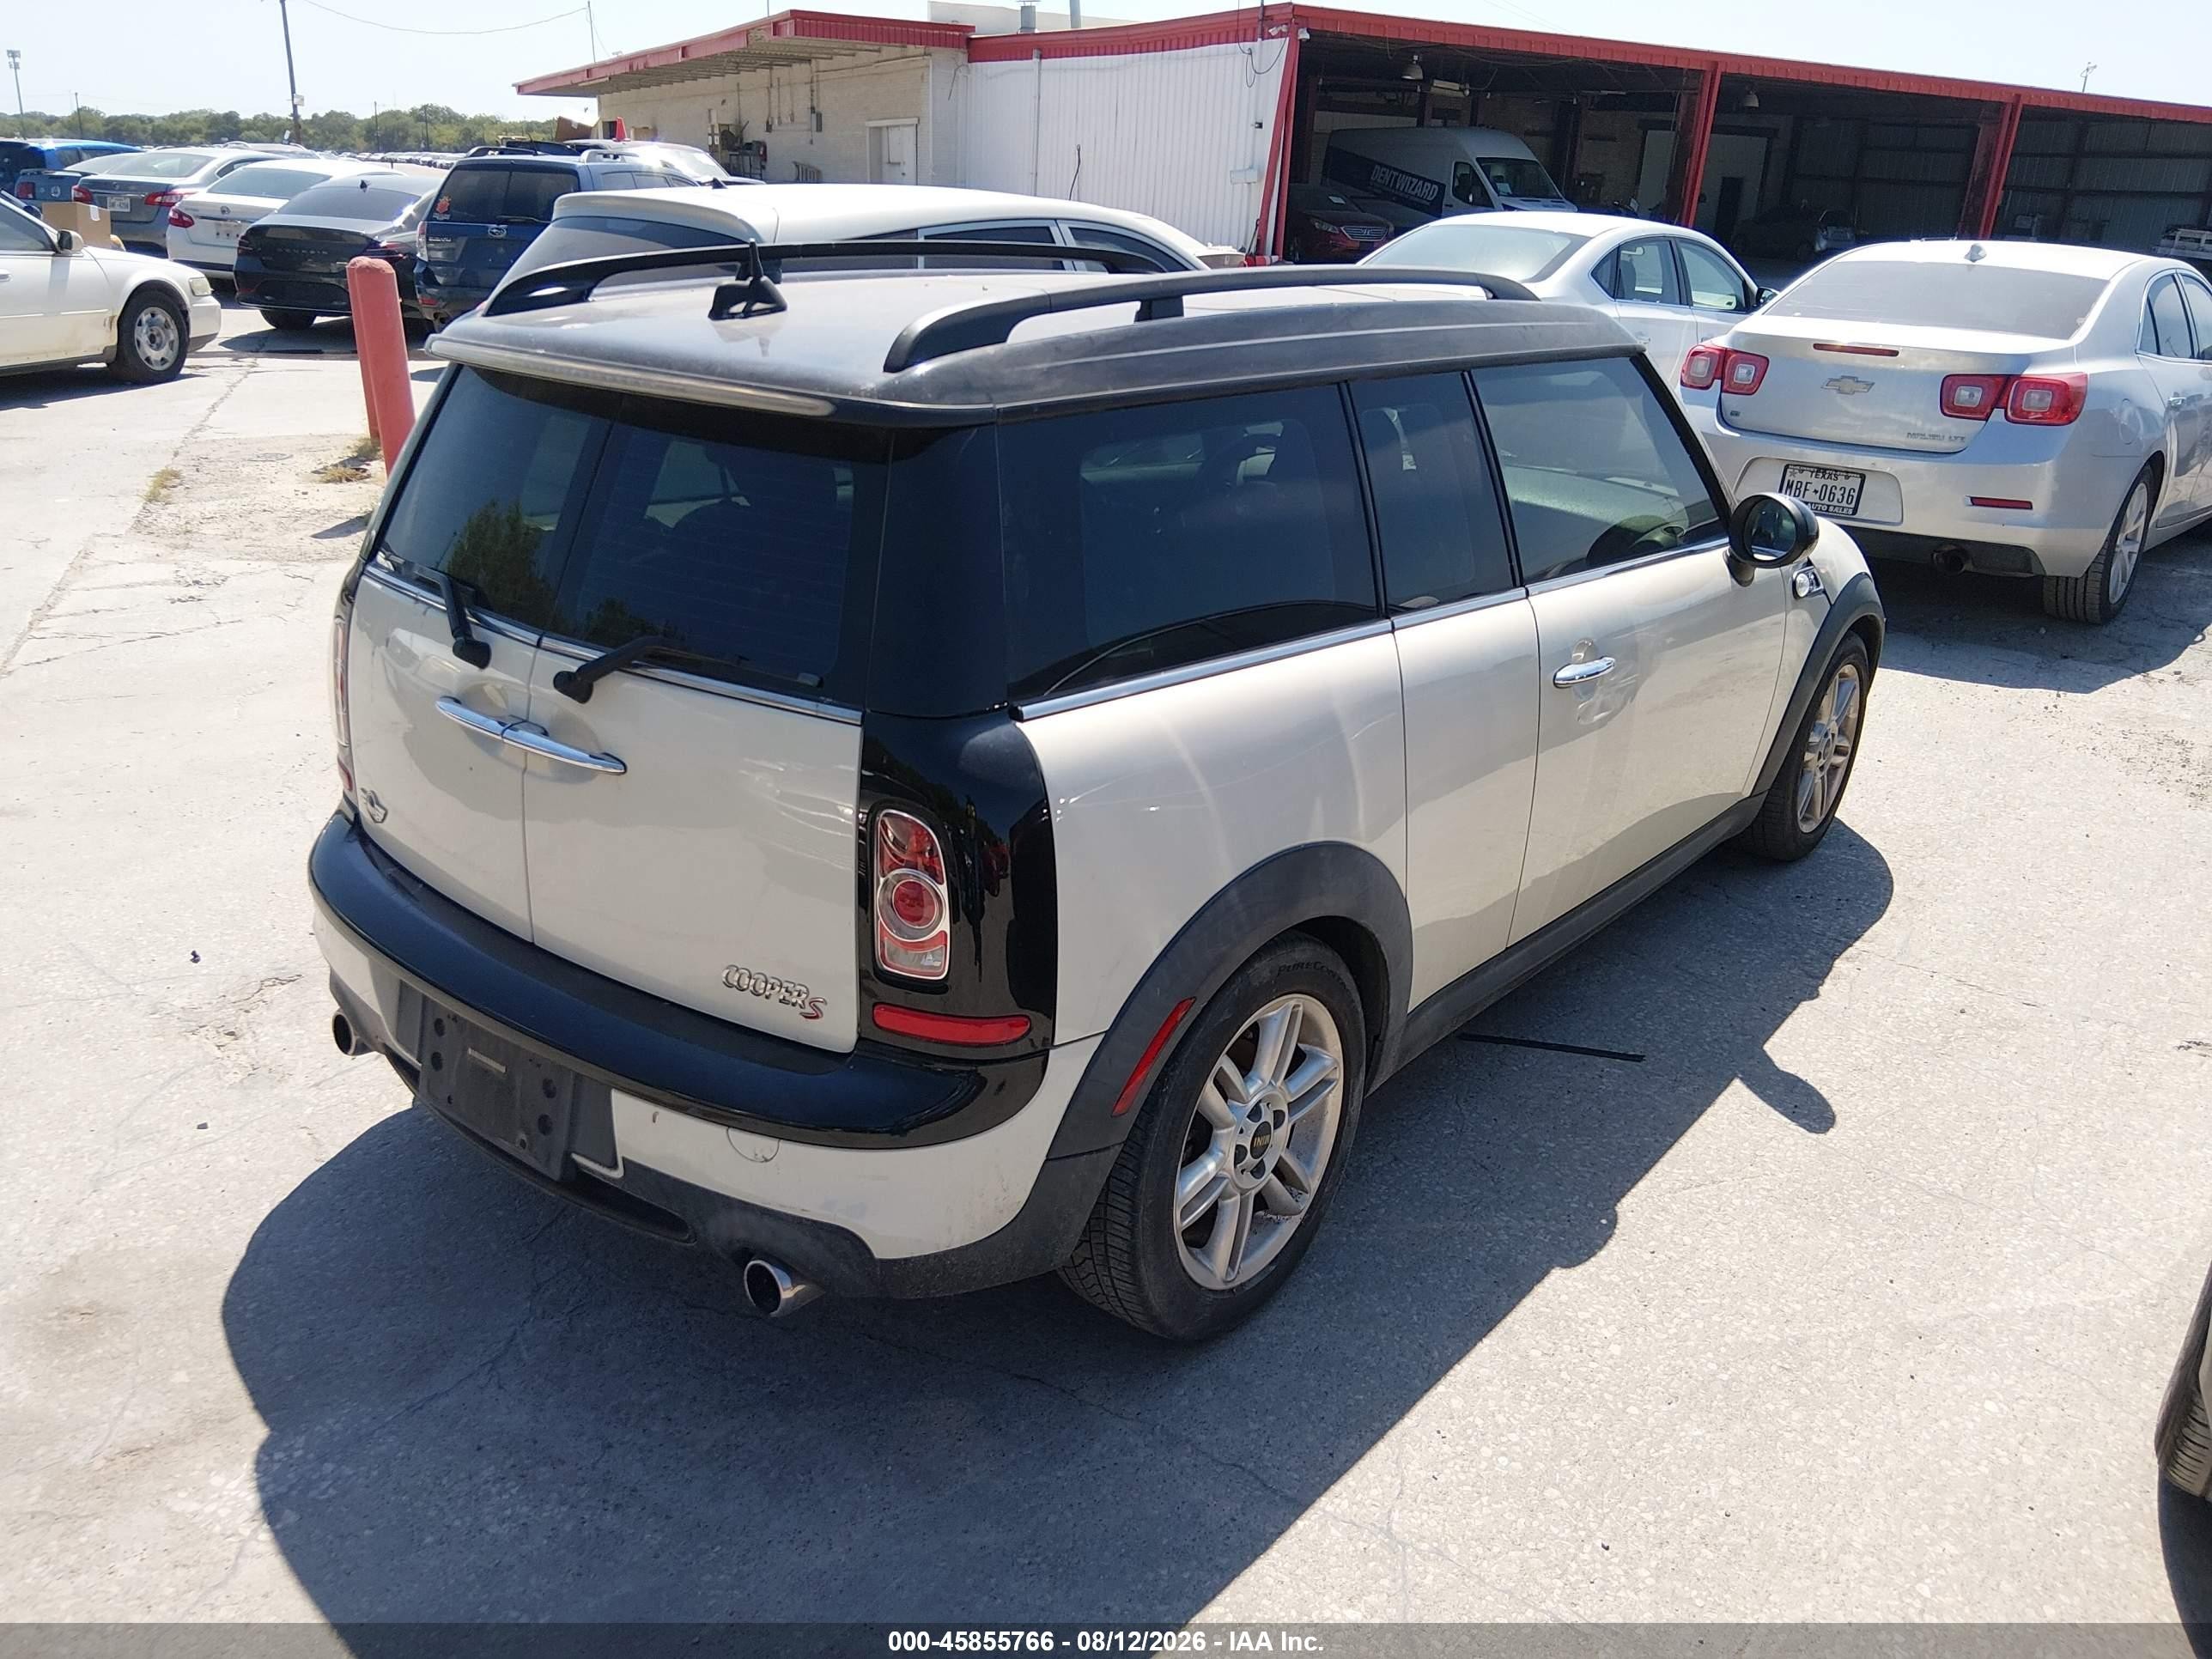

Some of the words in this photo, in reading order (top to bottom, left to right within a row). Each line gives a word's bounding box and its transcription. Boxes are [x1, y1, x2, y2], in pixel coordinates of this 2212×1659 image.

[1809, 469, 1838, 482] TEXAS
[1828, 505, 1853, 515] SALES
[721, 964, 810, 1010] COOPER
[799, 996, 828, 1020] S
